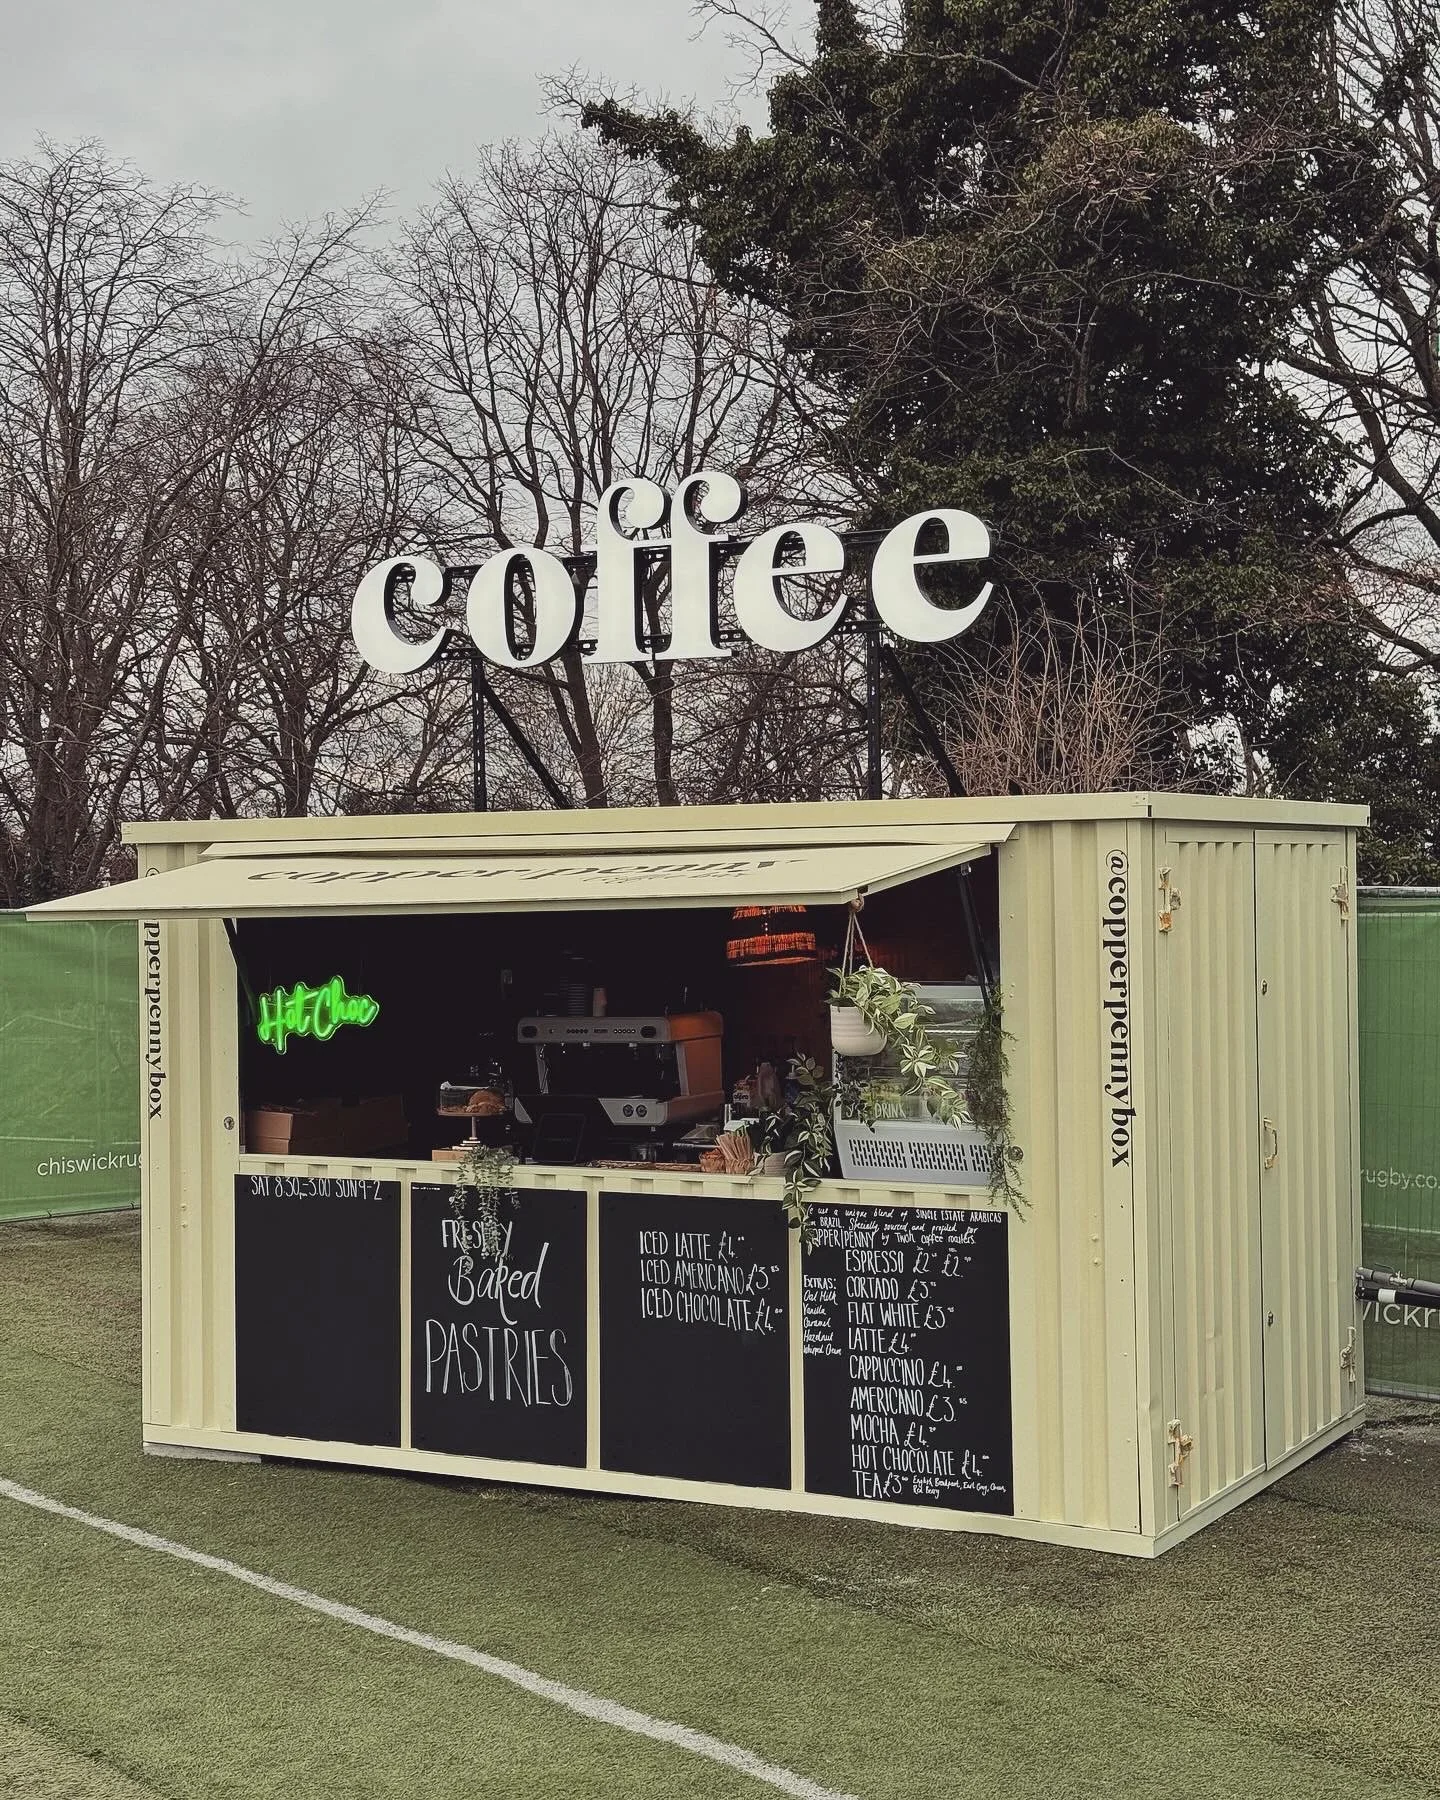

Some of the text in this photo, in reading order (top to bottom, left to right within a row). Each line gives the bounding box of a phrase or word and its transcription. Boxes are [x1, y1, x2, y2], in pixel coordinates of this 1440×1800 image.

[350, 471, 994, 674] coffee
[143, 867, 167, 1120] pperpennybox
[1102, 849, 1136, 1167] @copperpennybox
[260, 979, 376, 1051] Hot Choc
[251, 1175, 270, 1197] SAT
[335, 1179, 358, 1198] SUN
[940, 1210, 965, 1222] ESTATE
[969, 1211, 1002, 1224] ARABICAS
[639, 1231, 669, 1255] ICED
[675, 1232, 713, 1261] LATTE
[845, 1249, 904, 1274] ESPRESSO
[448, 1242, 549, 1326] Baked
[640, 1259, 671, 1285] ICED
[674, 1260, 745, 1295] AMERICANO
[846, 1276, 899, 1300] CORTADO
[641, 1287, 673, 1319] ICED
[676, 1290, 754, 1332] CHOCOLATE
[848, 1301, 875, 1325] FLAT
[879, 1302, 921, 1328] WHITE
[848, 1327, 887, 1354] LATTE
[425, 1319, 573, 1407] PASTRIES
[849, 1355, 925, 1386] CAPPUCCINO
[850, 1386, 924, 1416] AMERICANO
[851, 1414, 900, 1446] MOCHA
[852, 1444, 878, 1471] HOT
[882, 1446, 956, 1476] CHOCOLATE
[852, 1470, 883, 1499] TEA
